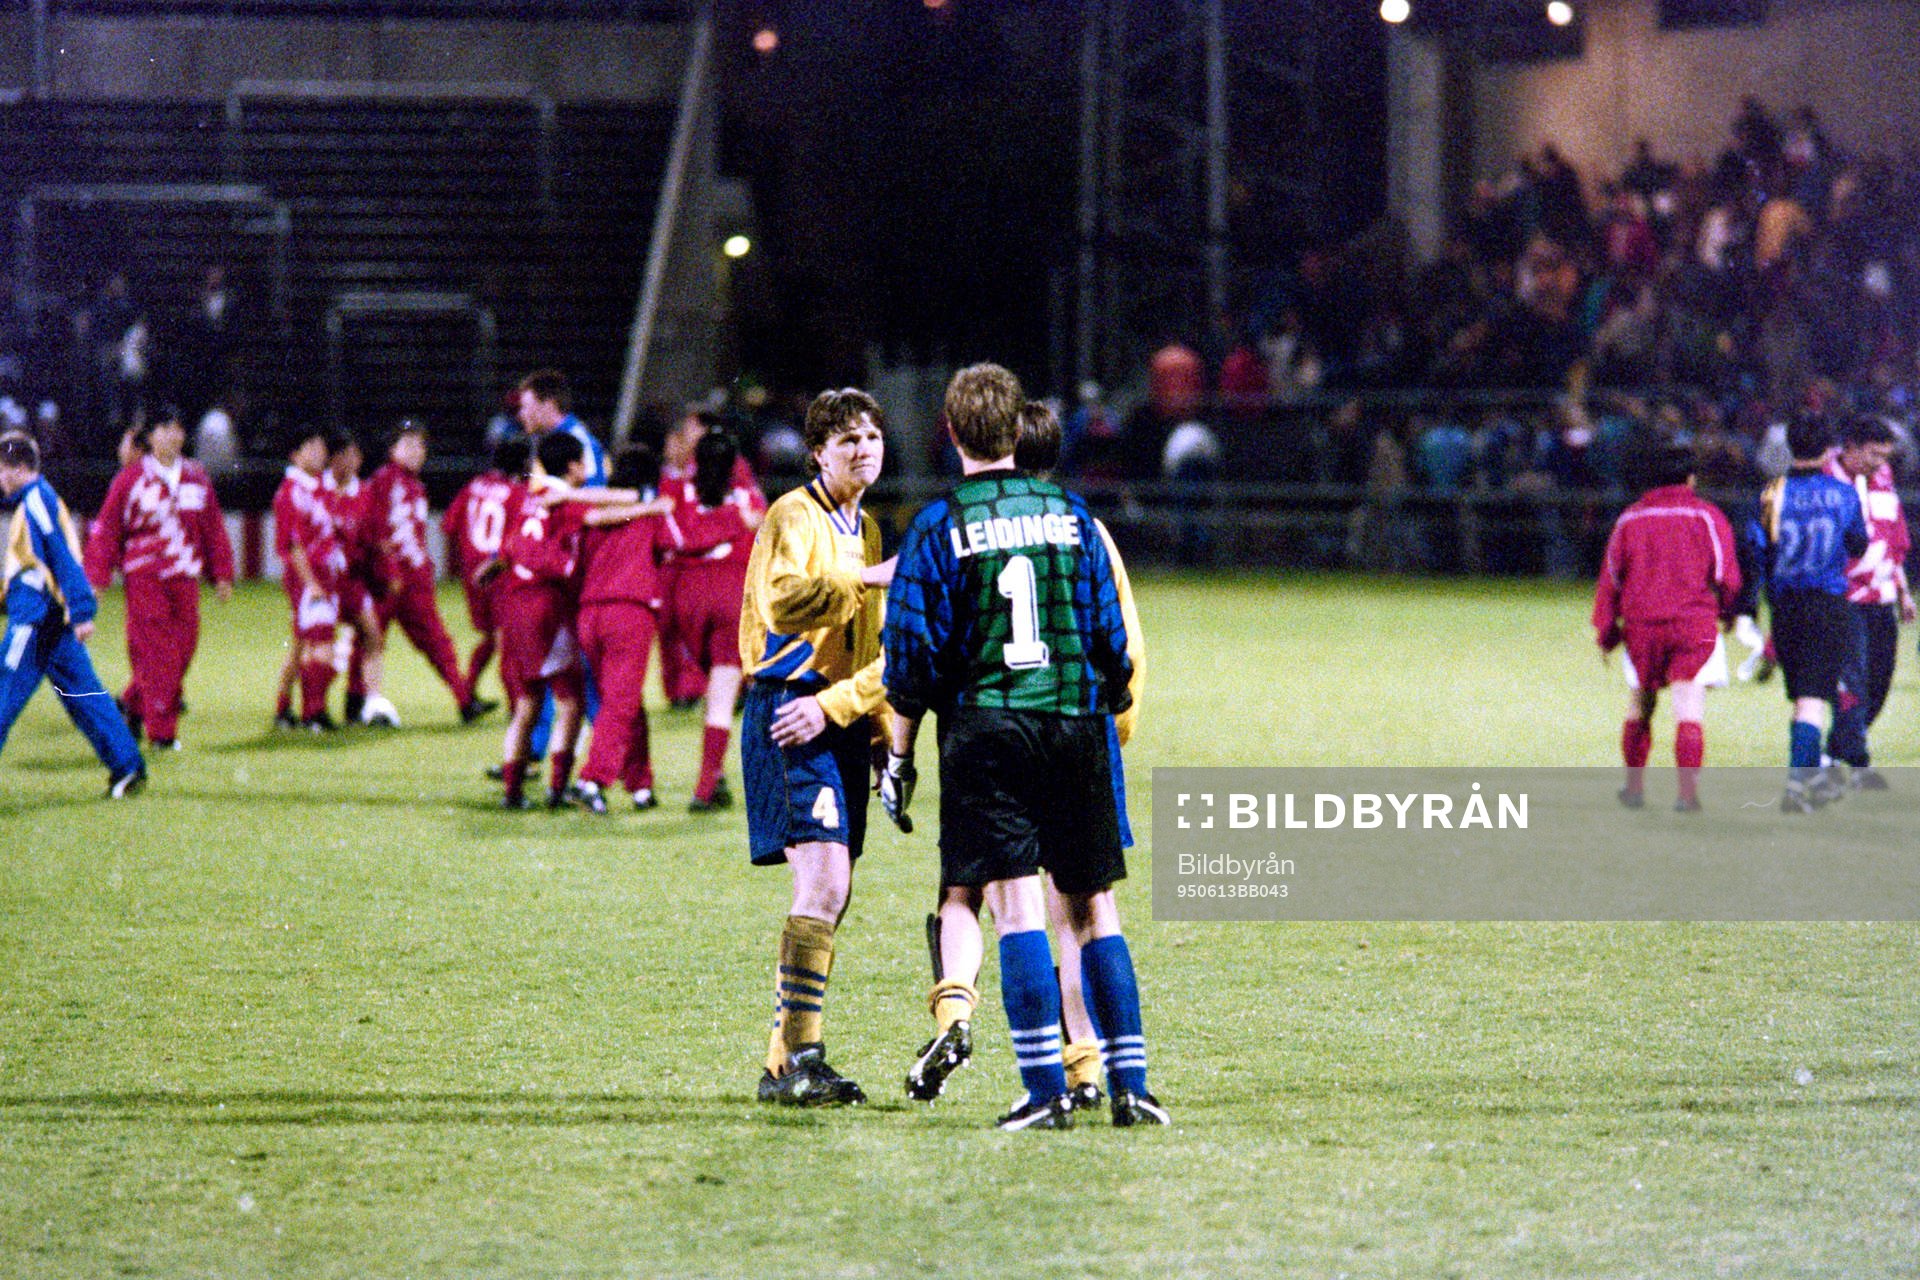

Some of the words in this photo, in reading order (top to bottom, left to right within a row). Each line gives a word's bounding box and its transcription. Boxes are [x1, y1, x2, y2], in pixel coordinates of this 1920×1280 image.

[950, 513, 1081, 559] LEIDINGE
[997, 554, 1050, 670] 1
[811, 786, 840, 829] 4
